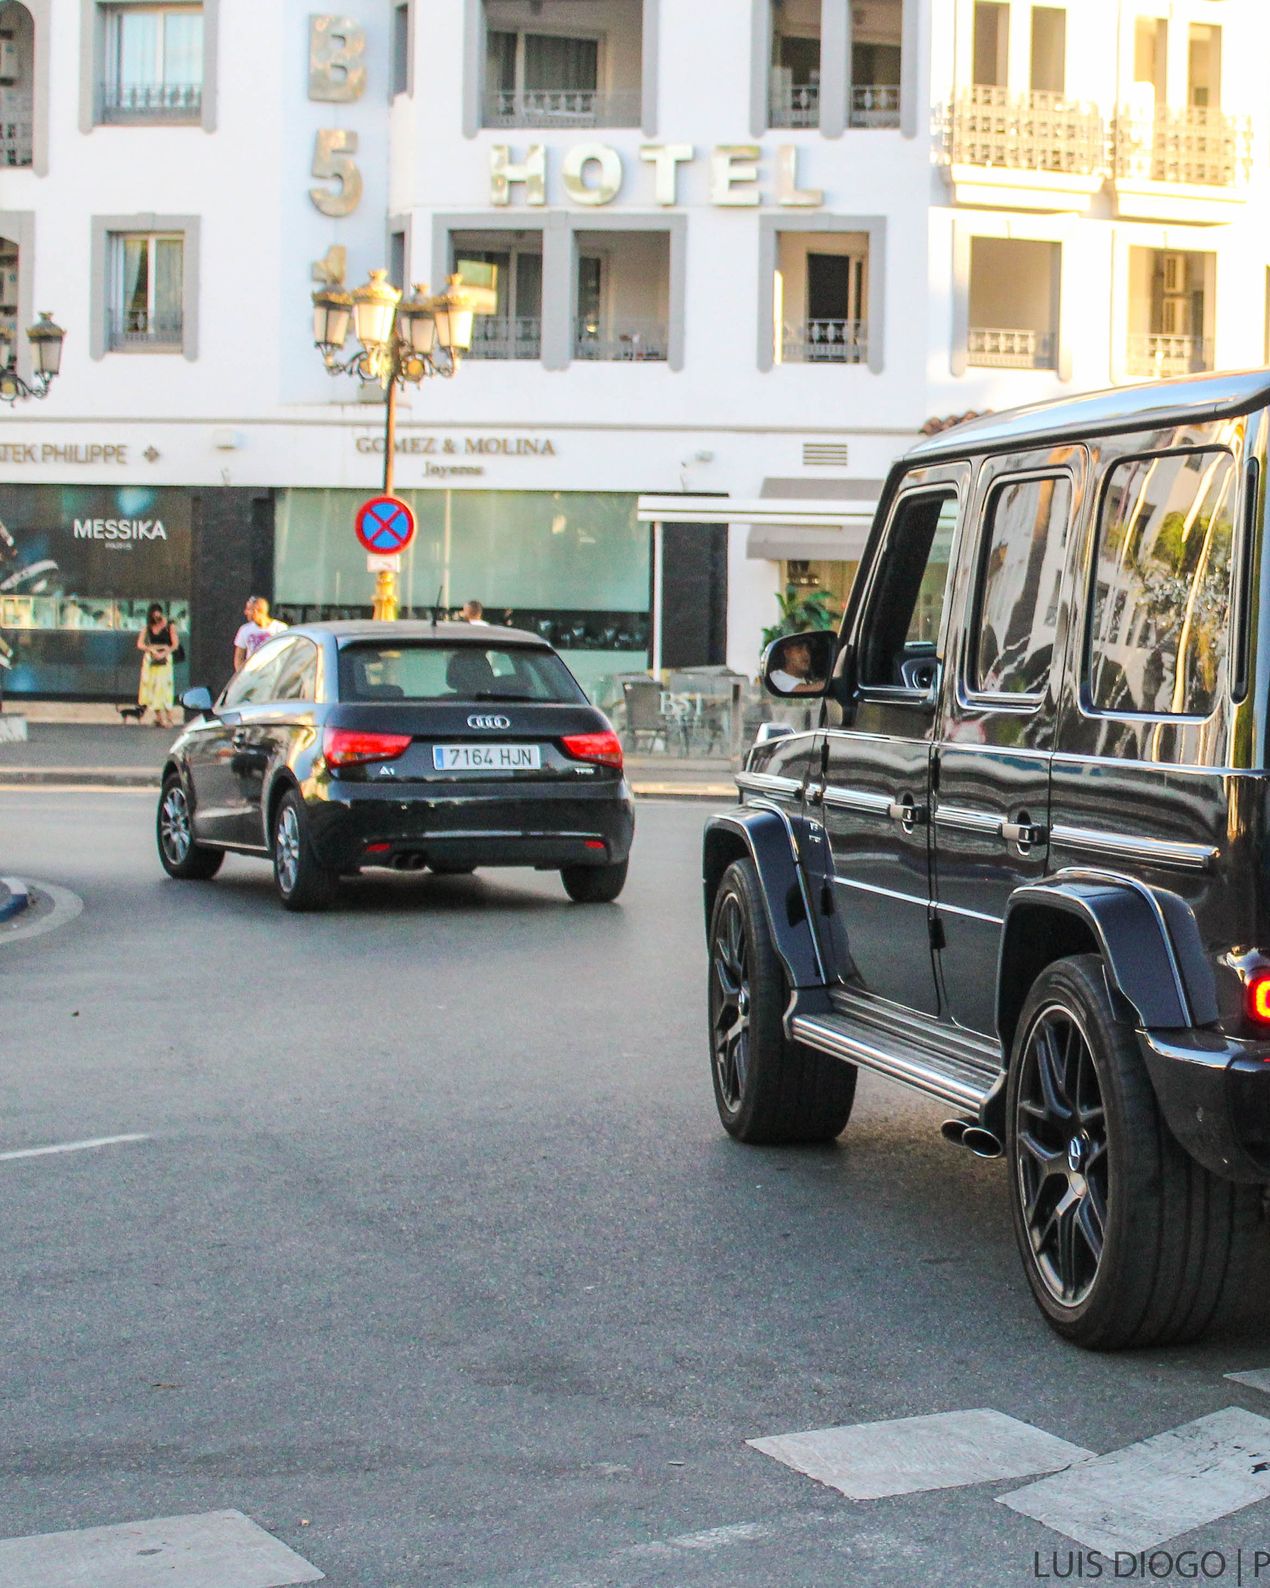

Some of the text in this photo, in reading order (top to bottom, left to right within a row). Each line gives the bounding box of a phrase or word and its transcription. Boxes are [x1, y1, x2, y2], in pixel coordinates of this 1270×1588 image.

[490, 143, 824, 207] HOTEL
[0, 443, 128, 465] TEK PHILIPPE
[443, 438, 455, 455] &
[464, 438, 557, 456] MOLINA
[73, 518, 167, 541] MESSIKA
[449, 749, 532, 766] 7164 HJN
